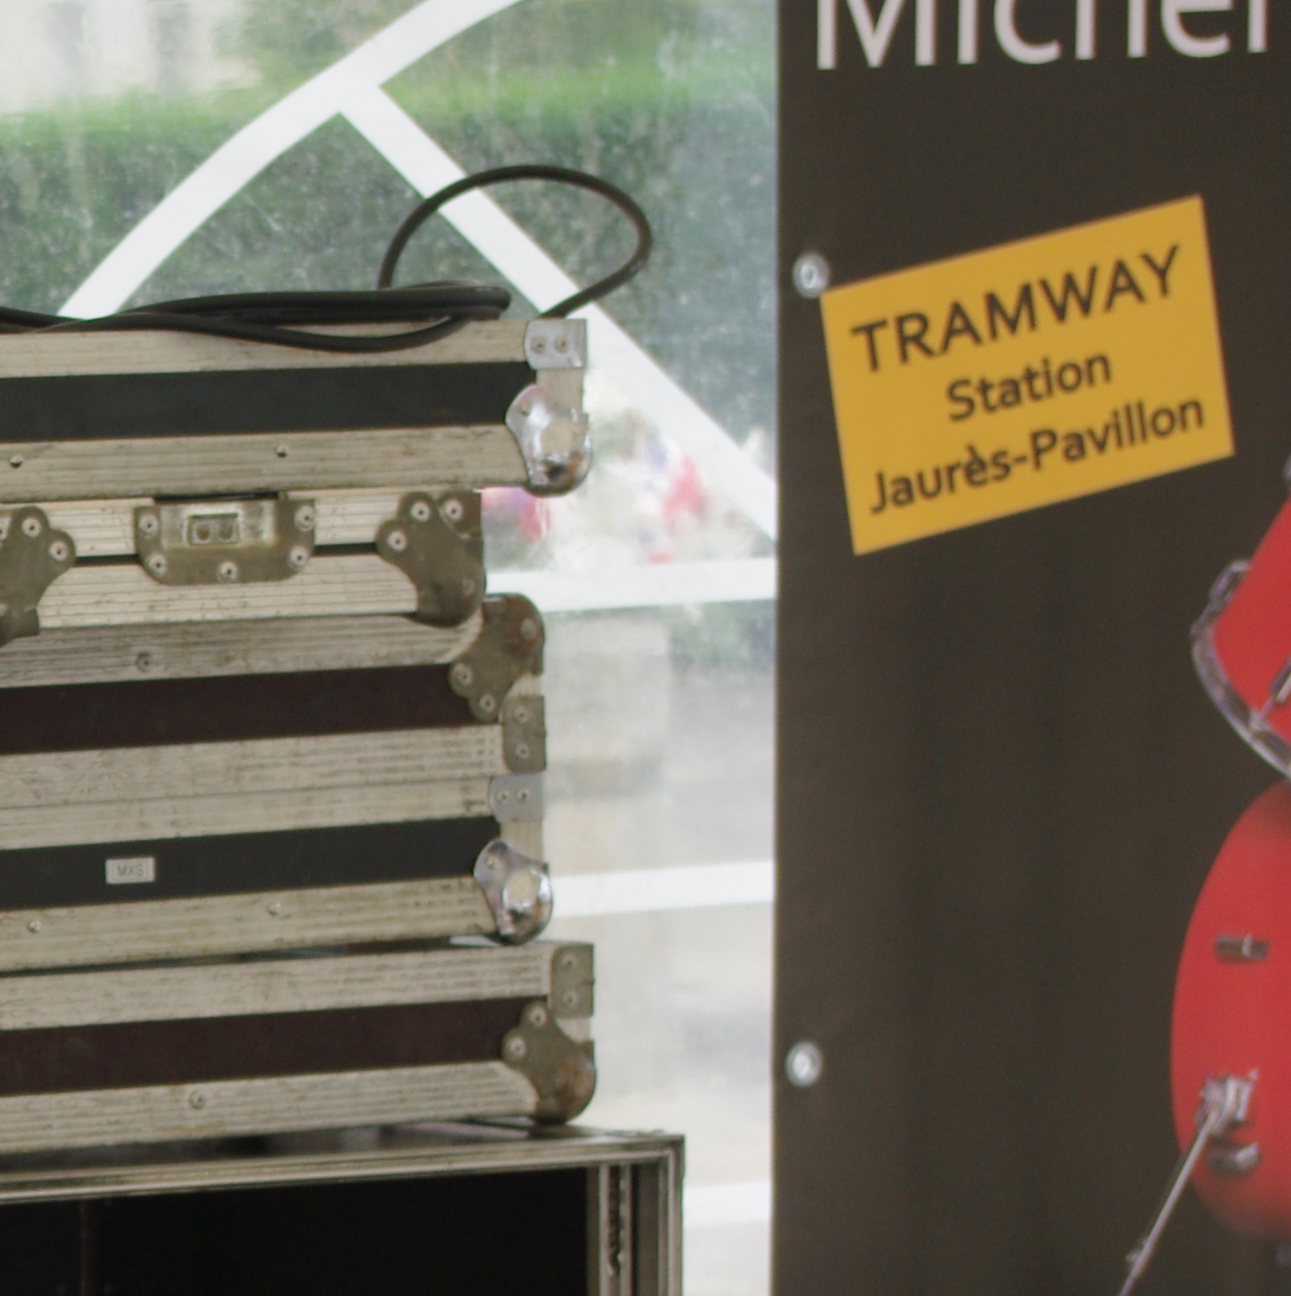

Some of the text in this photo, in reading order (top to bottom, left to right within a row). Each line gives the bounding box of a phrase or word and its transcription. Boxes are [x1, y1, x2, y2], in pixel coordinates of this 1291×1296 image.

[850, 245, 1180, 373] TRAMWAY
[946, 354, 1113, 423] Station
[870, 398, 1205, 516] Jaurès-Pavillon
